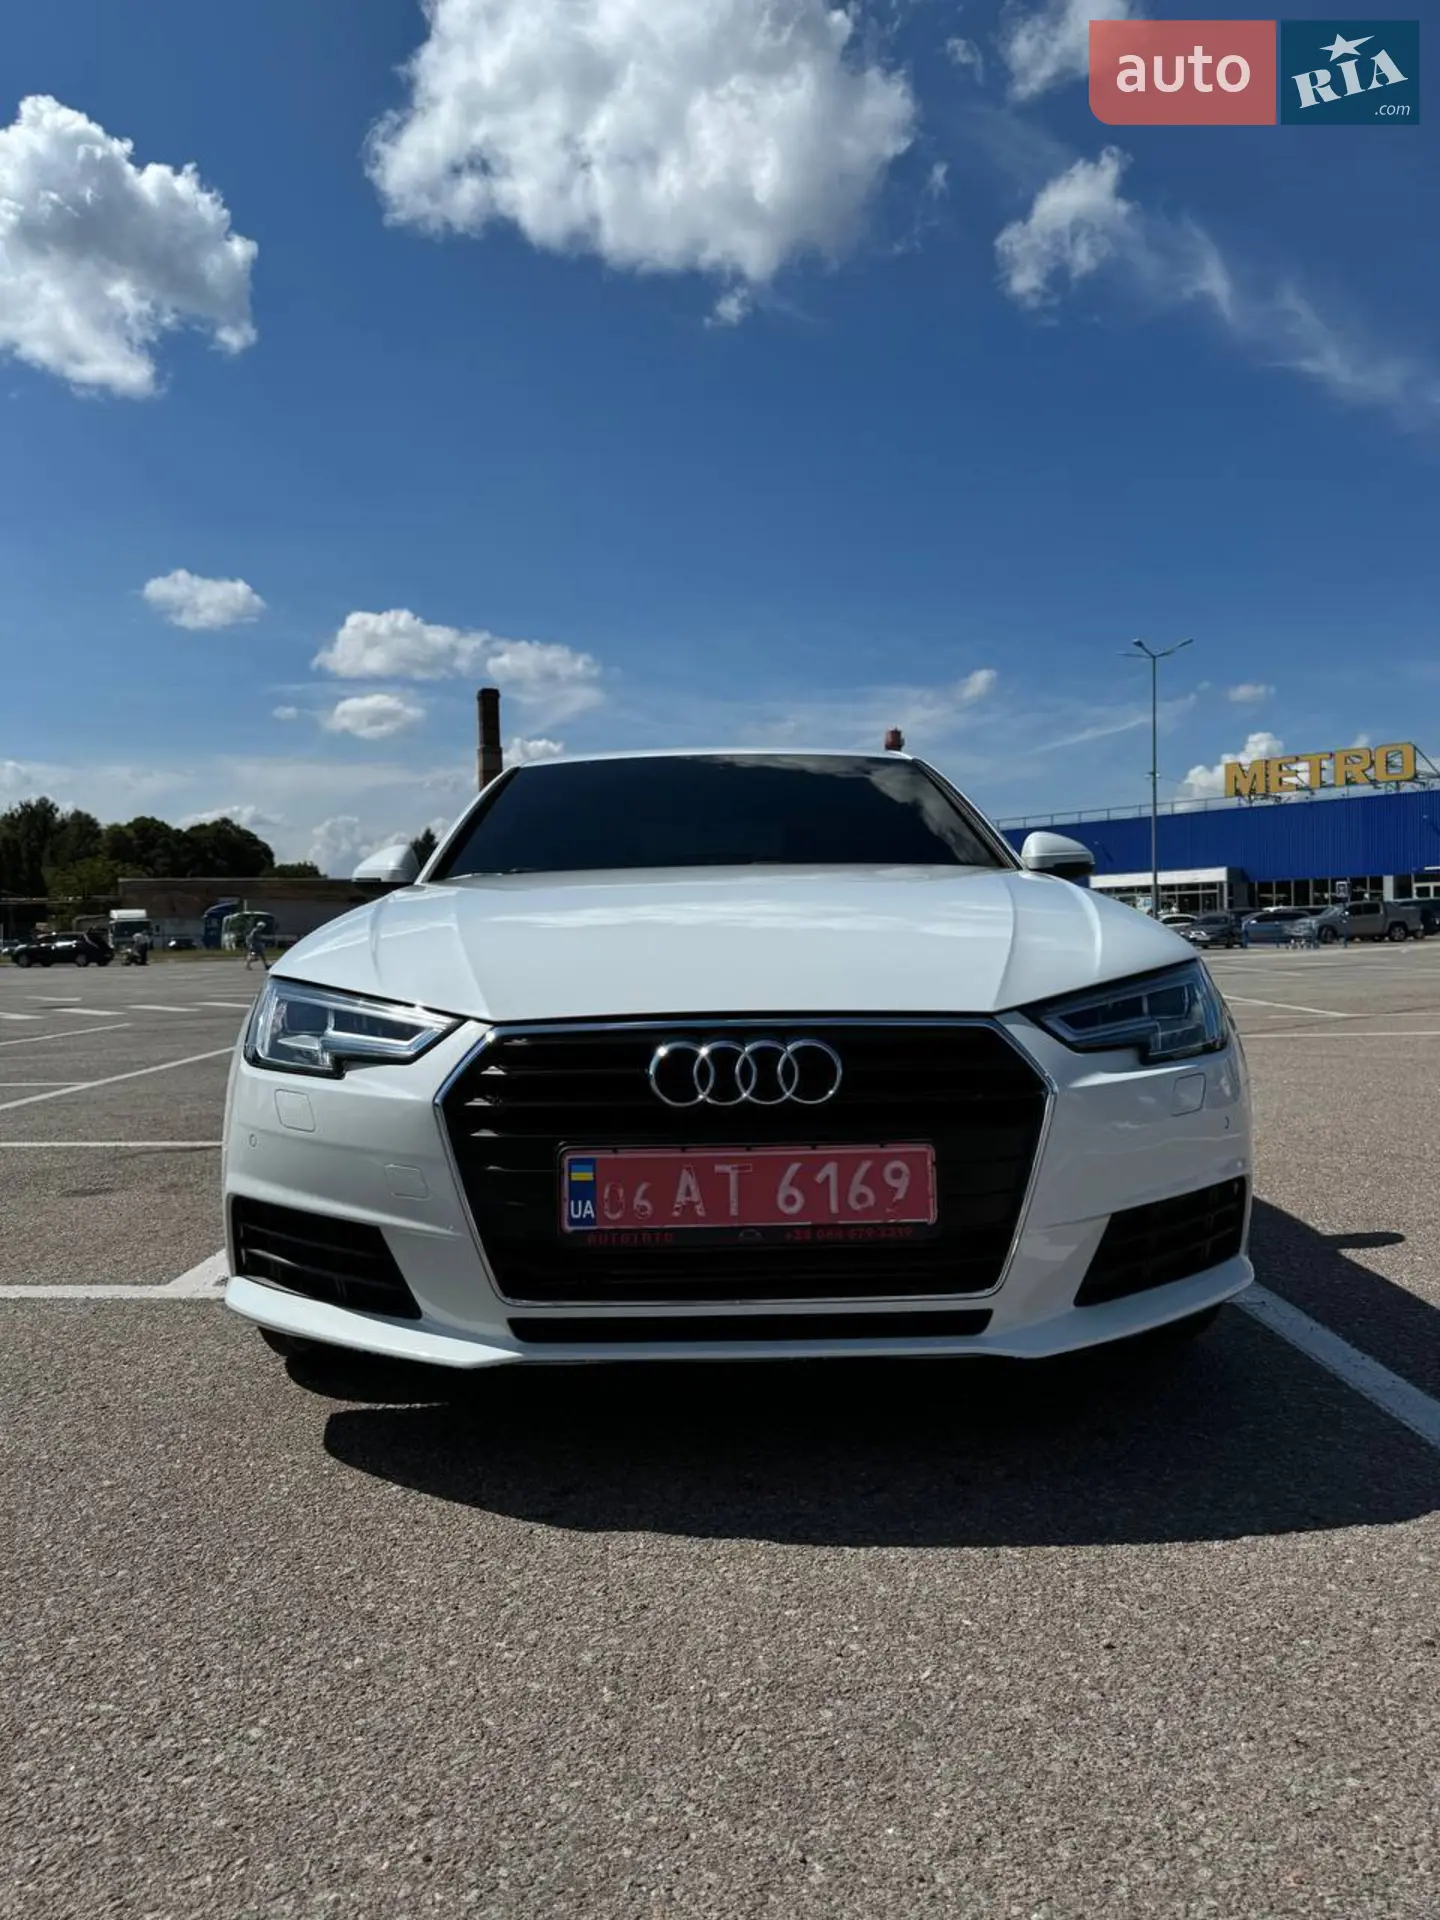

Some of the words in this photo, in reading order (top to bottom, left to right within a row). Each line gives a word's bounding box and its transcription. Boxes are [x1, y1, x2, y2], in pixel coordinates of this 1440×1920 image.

[1224, 741, 1417, 798] METRO
[570, 1200, 595, 1218] UA
[603, 1181, 654, 1220] 06
[672, 1164, 753, 1217] AT
[776, 1160, 911, 1216] 6169
